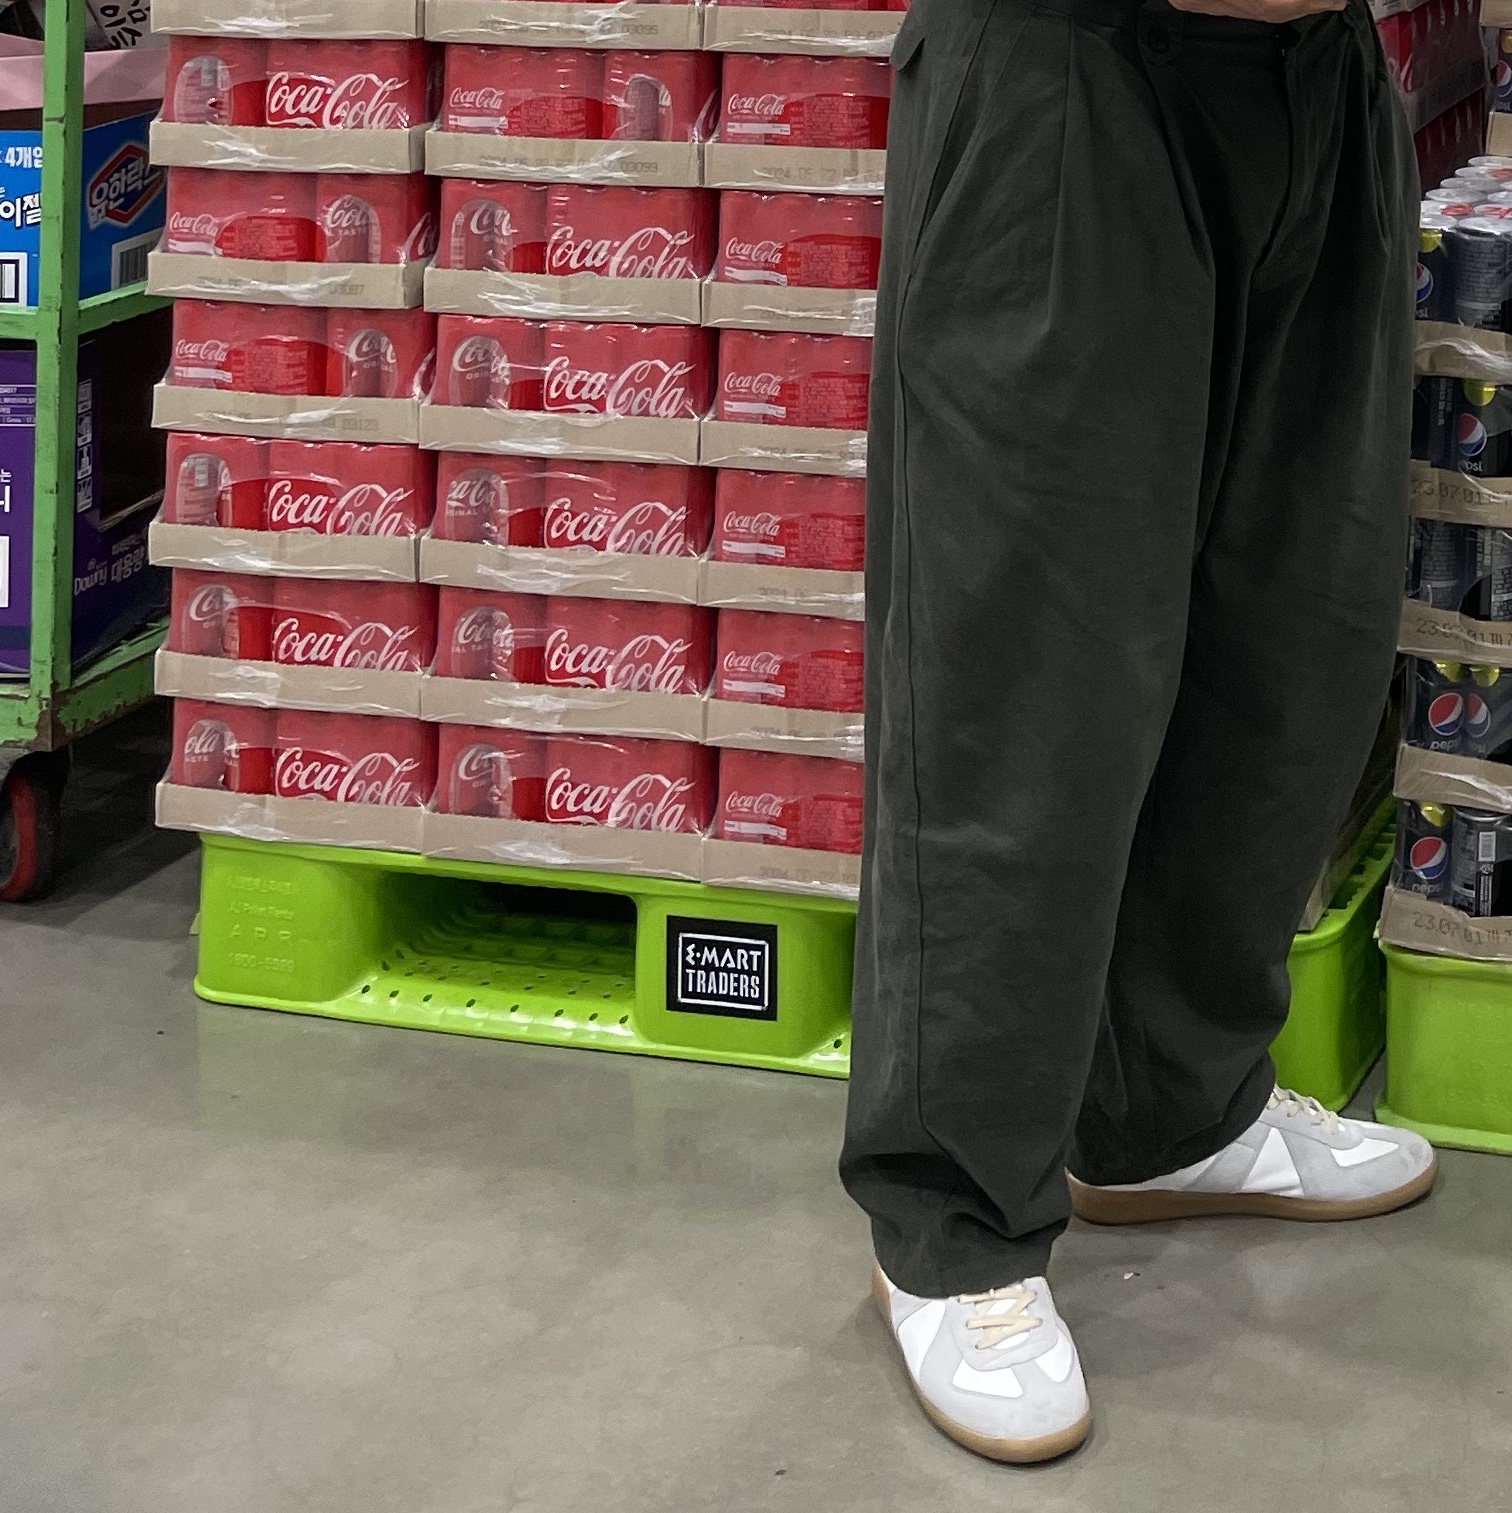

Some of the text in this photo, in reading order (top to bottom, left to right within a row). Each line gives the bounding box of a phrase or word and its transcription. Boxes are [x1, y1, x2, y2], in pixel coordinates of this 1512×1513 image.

[266, 70, 408, 128] Coca-Cola
[450, 87, 502, 110] Coca-Cola
[727, 93, 785, 118] Coca-Cola
[169, 211, 219, 236] Coca-Cola
[549, 225, 695, 280] Coca-Cola
[726, 236, 781, 265] Coca-Cola
[175, 338, 227, 363] Coca-Cola
[545, 356, 696, 419] Coca-Cola
[725, 371, 781, 397] Coca-Cola
[269, 478, 415, 537] Coca-Cola
[546, 497, 689, 556] Coca-Cola
[723, 510, 779, 538] Coca-Cola
[74, 563, 107, 597] Downy
[273, 617, 420, 672] Coca-Cola
[546, 628, 693, 694] Coca-Cola
[723, 649, 780, 677] Coca-Cola
[276, 746, 422, 805] Coca-Cola
[546, 767, 696, 833] Coca-Cola
[725, 791, 782, 819] Coca-Cola
[685, 968, 760, 999] TRADERS
